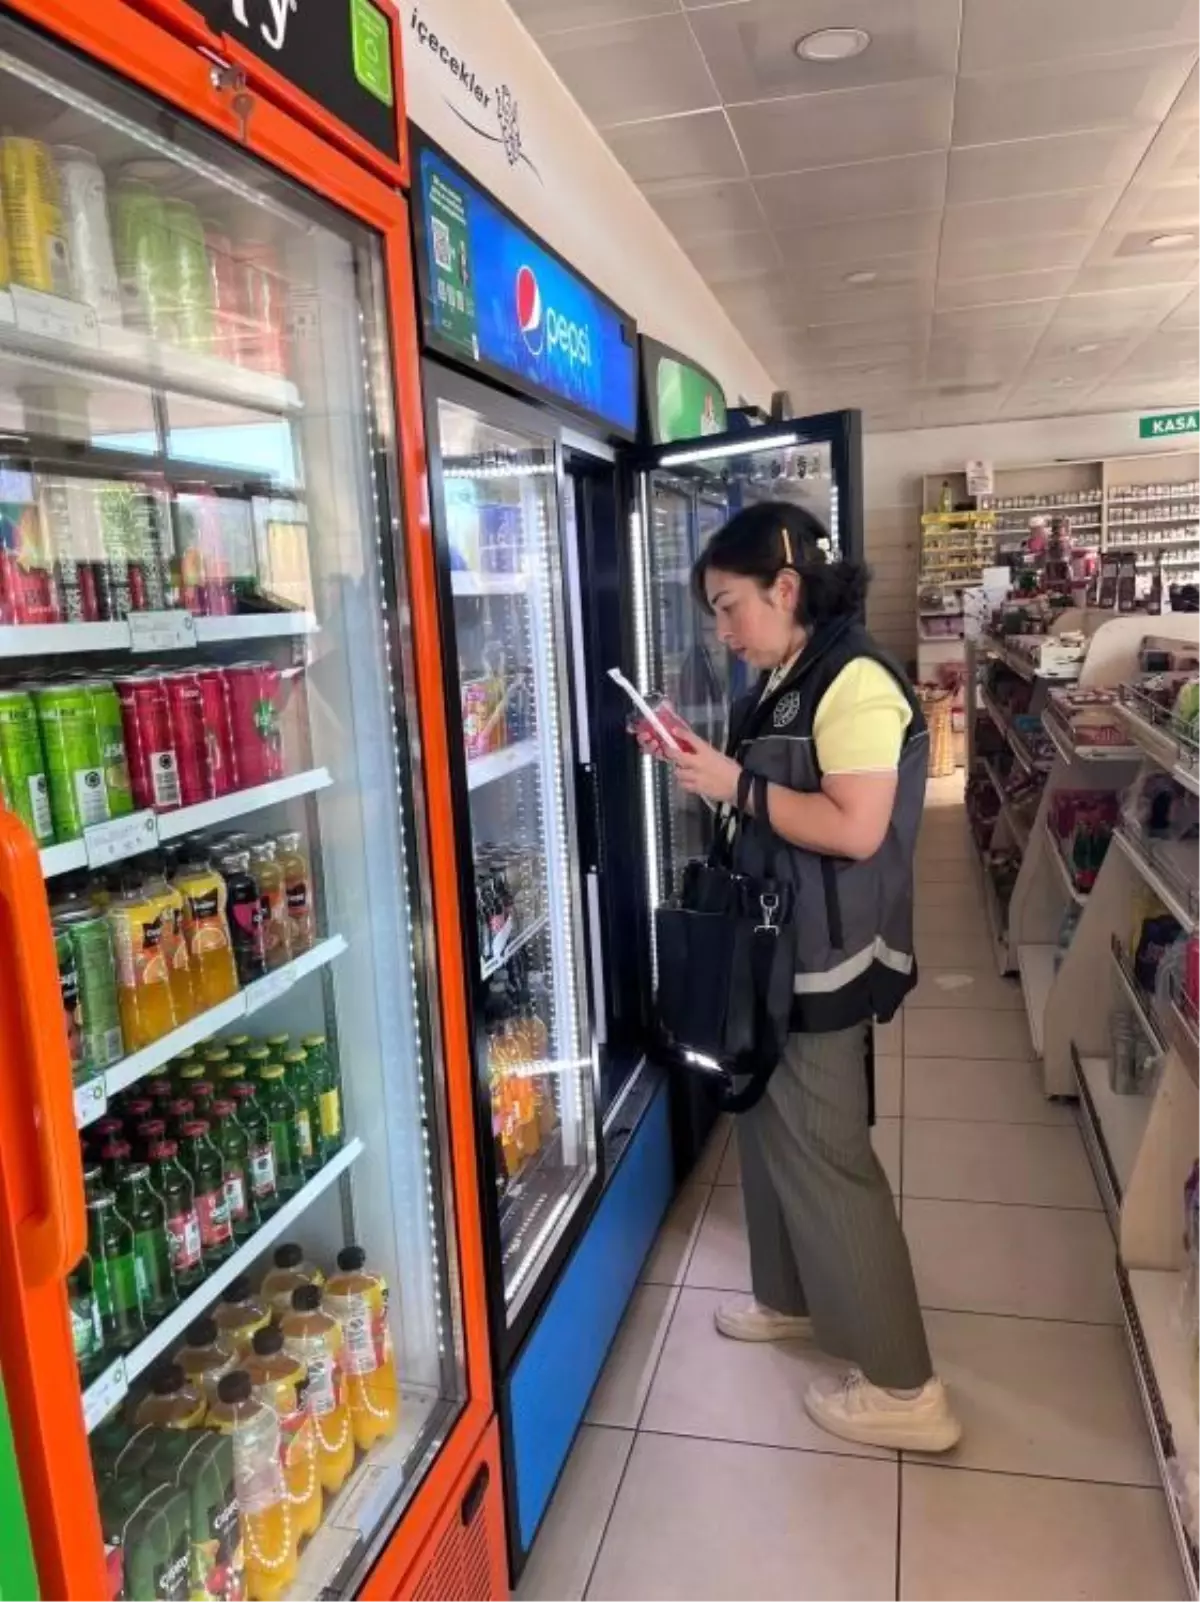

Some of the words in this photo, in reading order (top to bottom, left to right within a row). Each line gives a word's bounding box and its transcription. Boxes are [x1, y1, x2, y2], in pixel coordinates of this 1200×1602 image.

[410, 8, 491, 108] içecekler
[546, 307, 592, 368] pepsi
[1152, 415, 1198, 434] KASA
